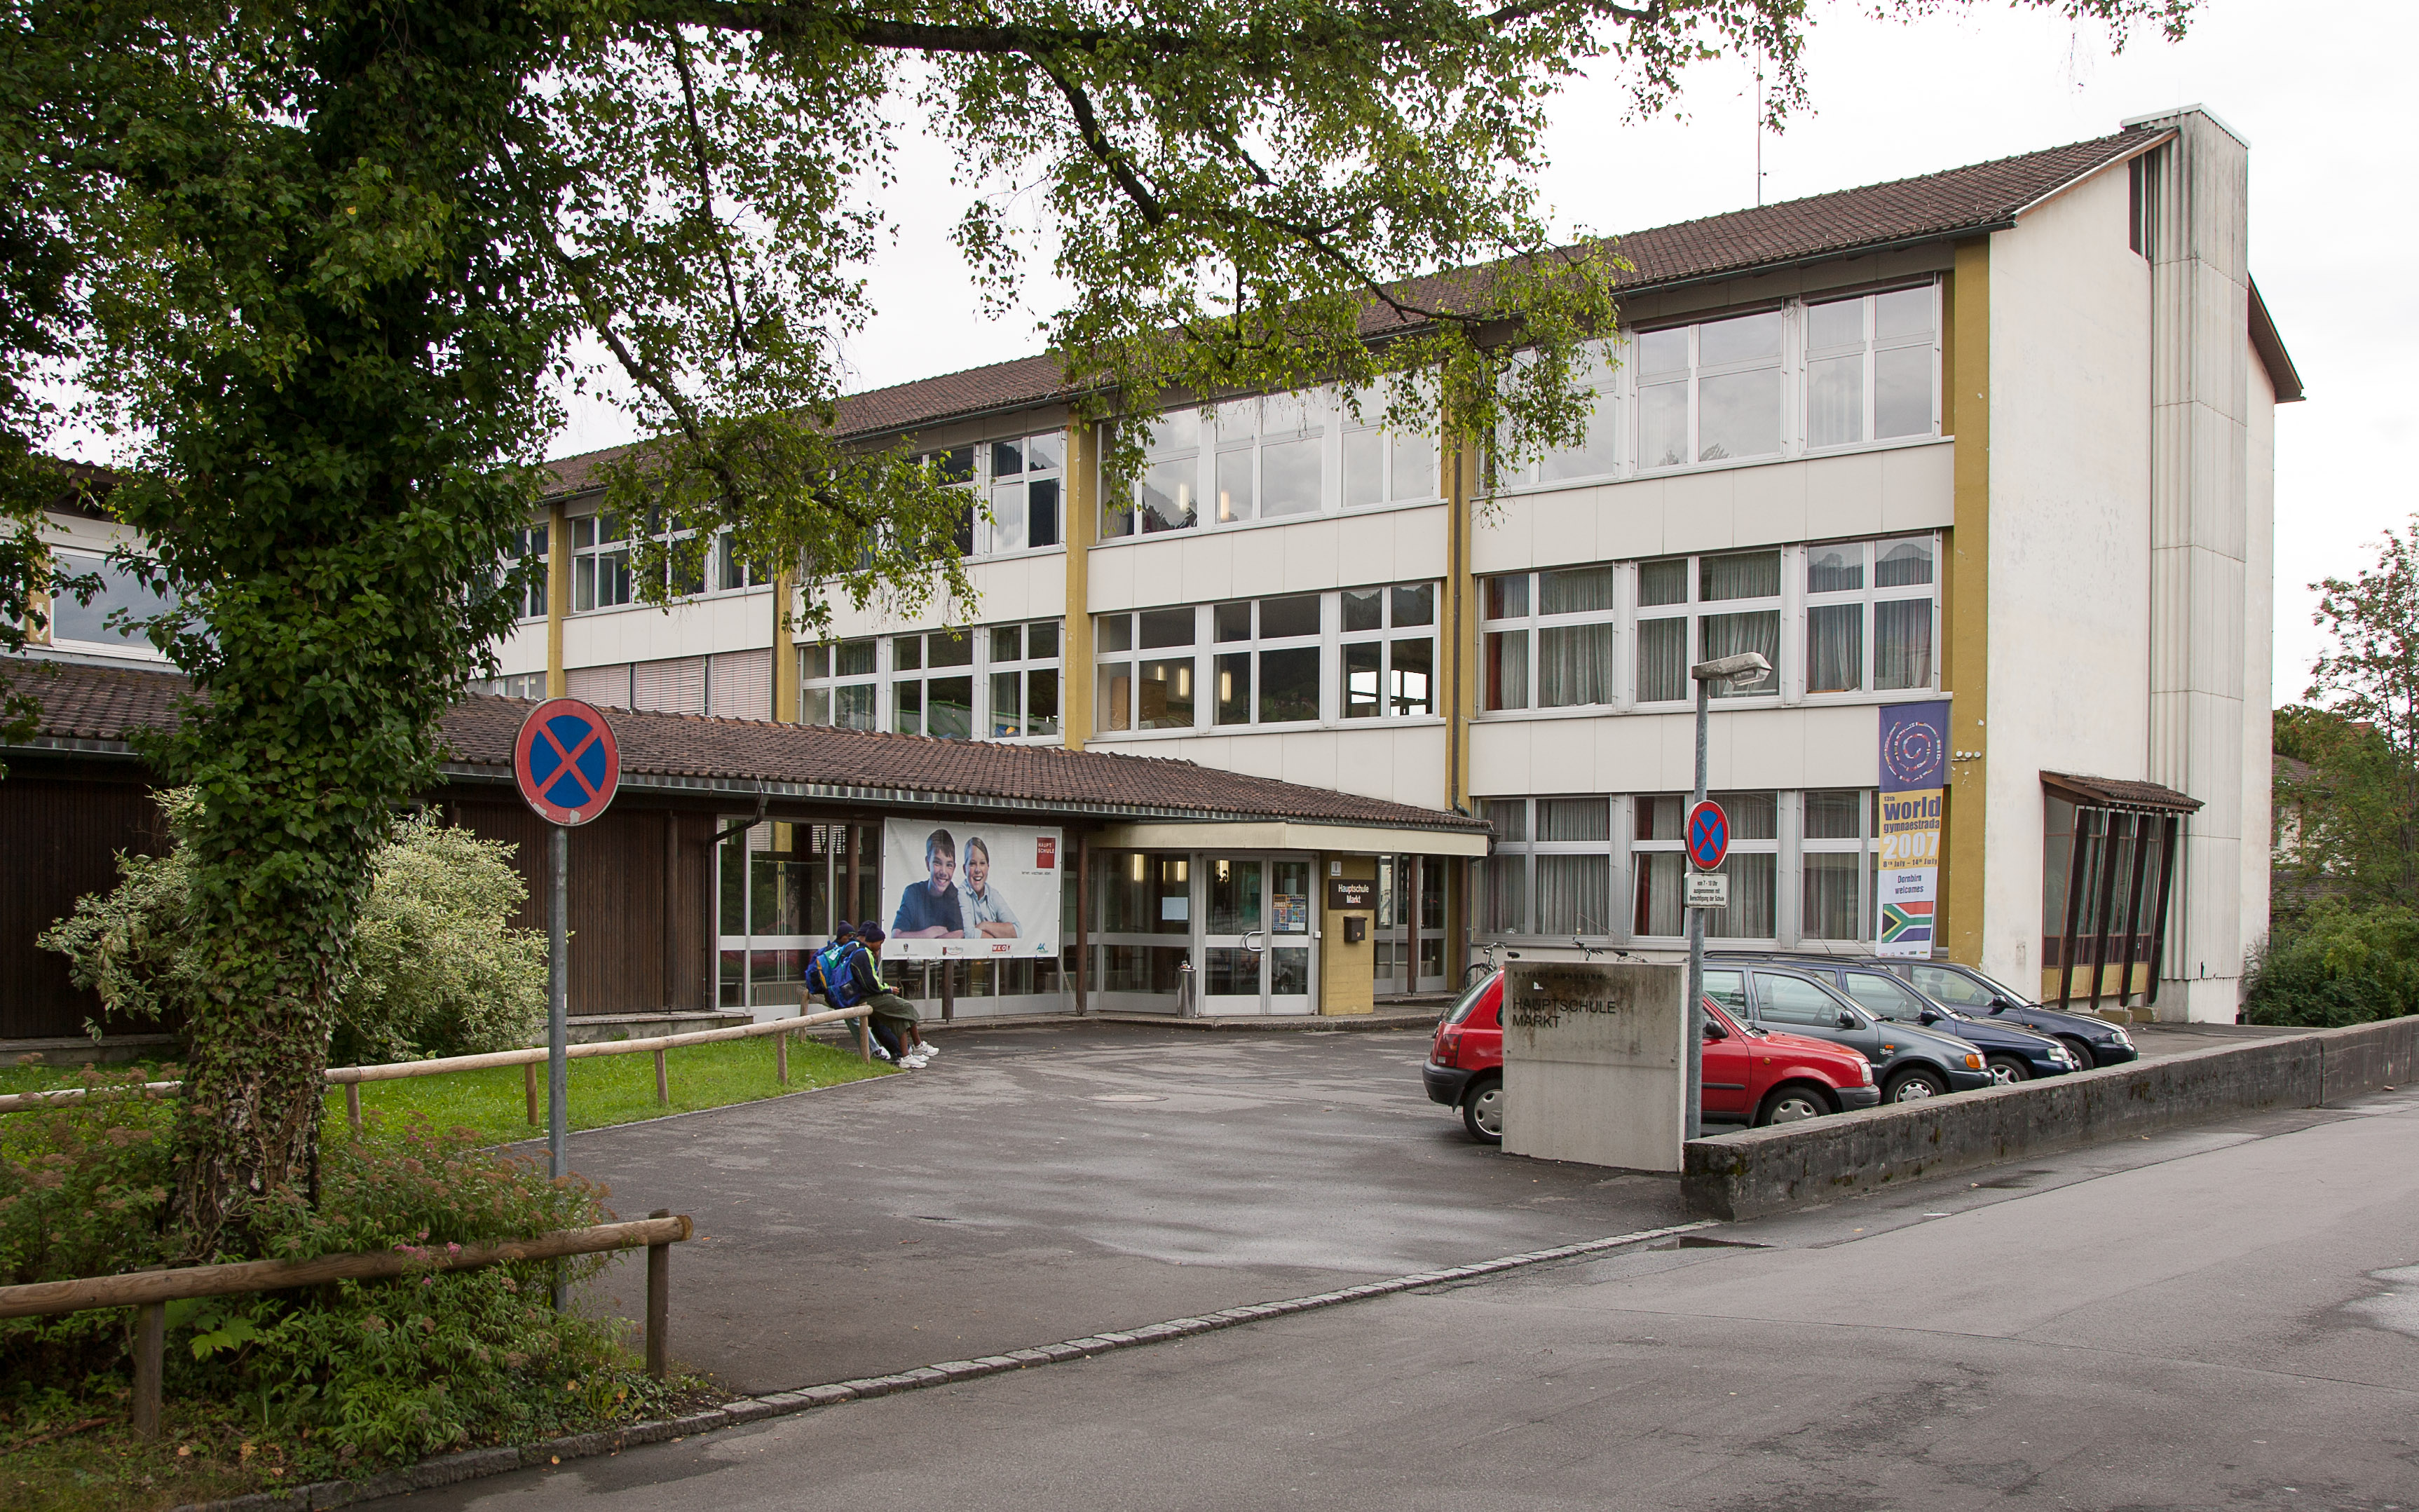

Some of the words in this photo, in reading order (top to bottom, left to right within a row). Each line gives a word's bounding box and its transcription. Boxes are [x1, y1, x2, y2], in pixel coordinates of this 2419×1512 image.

[1883, 796, 1941, 821] world
[1883, 818, 1940, 833] gymnaestrada
[1883, 831, 1940, 859] 2007
[1897, 873, 1922, 883] Dornbirn
[1338, 884, 1369, 894] Hauptschule
[1895, 885, 1924, 894] welcomes
[1347, 894, 1361, 904] Markt
[1513, 997, 1616, 1014] HAUPTSCHULE
[1513, 1014, 1561, 1028] MARKT
